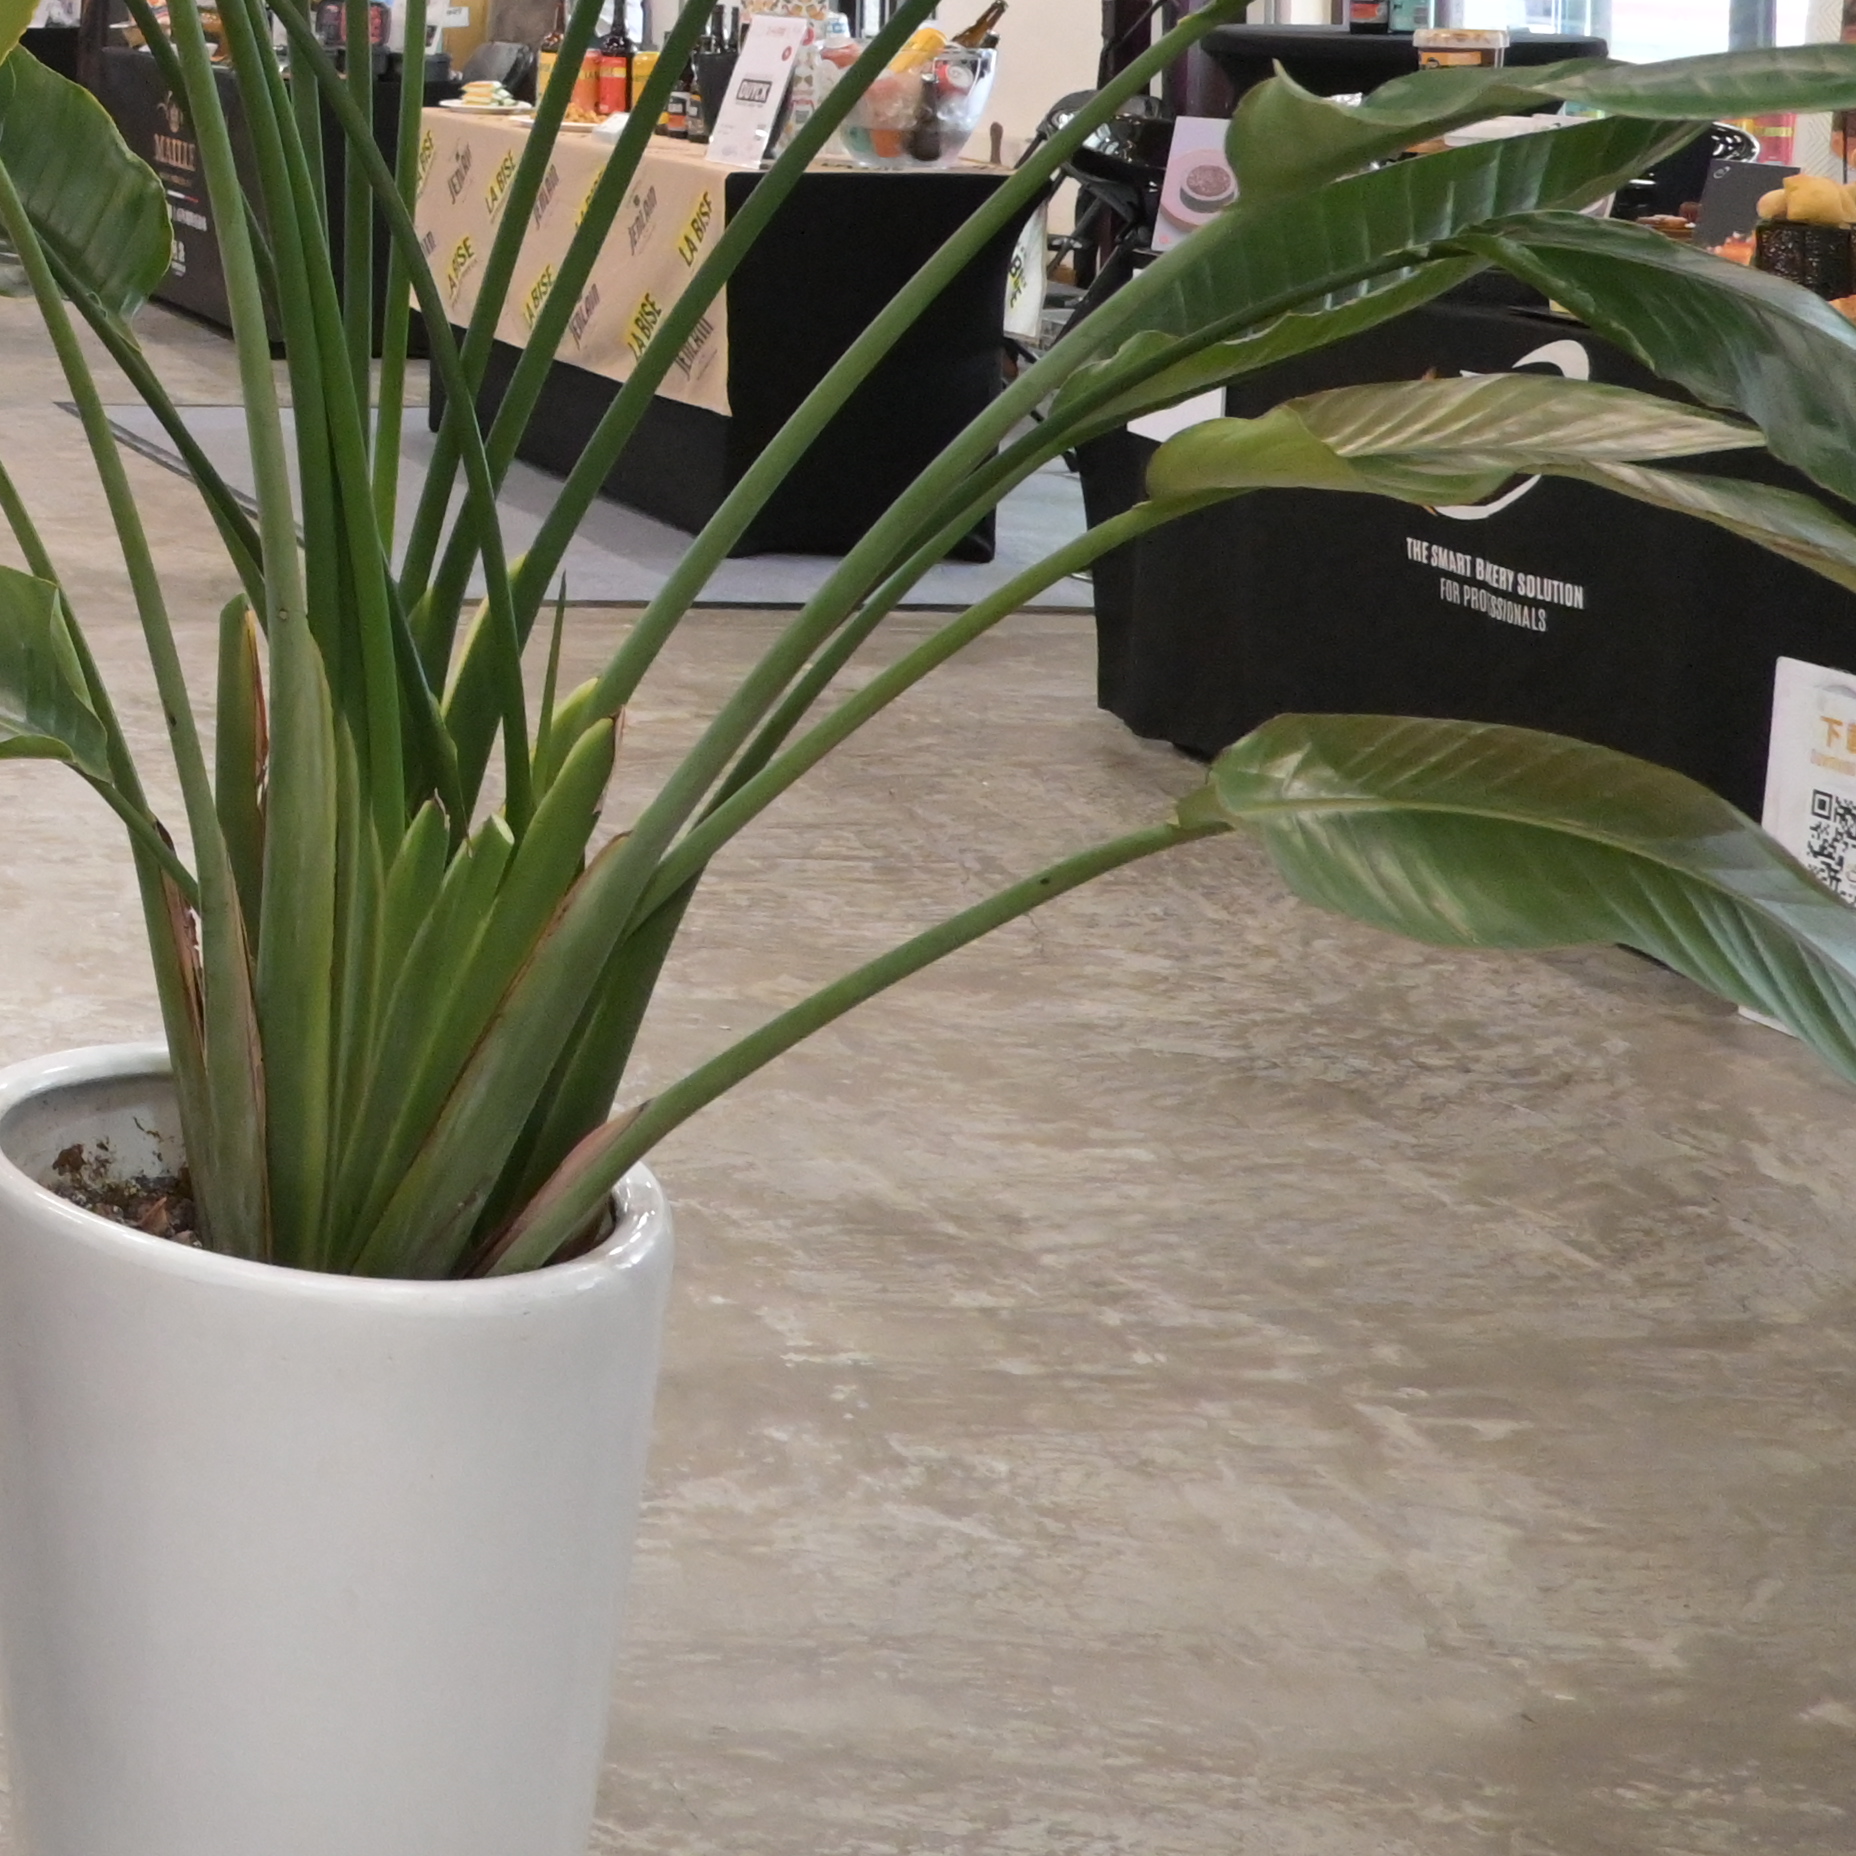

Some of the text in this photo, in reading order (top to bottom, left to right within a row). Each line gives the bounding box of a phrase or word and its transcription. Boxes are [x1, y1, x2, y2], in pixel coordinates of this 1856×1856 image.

[496, 149, 516, 192] BISE
[678, 191, 714, 268] LA BISE
[530, 264, 554, 309] BISE
[640, 292, 662, 340] BISE
[1406, 537, 1429, 564] THE
[1431, 545, 1472, 577] SMART
[1517, 572, 1584, 609] SOLUTION
[1440, 578, 1460, 605] FOR
